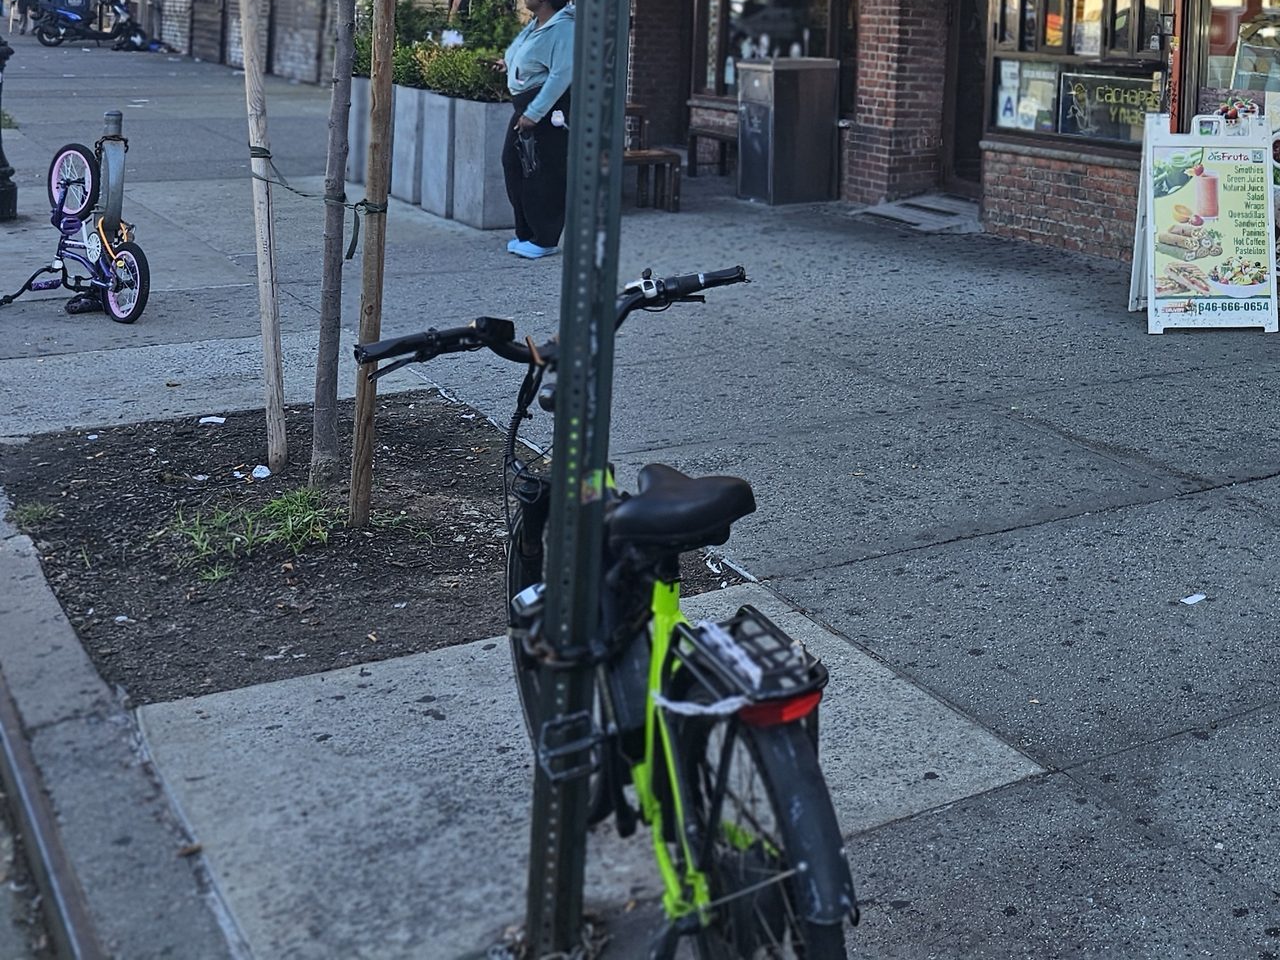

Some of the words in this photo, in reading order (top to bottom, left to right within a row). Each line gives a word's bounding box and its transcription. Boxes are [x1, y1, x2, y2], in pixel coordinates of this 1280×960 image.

[1002, 96, 1015, 117] A
[1207, 151, 1250, 161] disFruta
[1247, 174, 1264, 183] Juice
[1223, 183, 1246, 192] Natural
[1247, 183, 1264, 192] Juice
[1247, 192, 1264, 201] Salad
[1244, 201, 1264, 210] Wraps
[1228, 210, 1265, 219] Quesadillas
[1234, 219, 1265, 228] Sandwich
[1242, 228, 1265, 237] Paninis
[1233, 237, 1244, 246] Hot
[1245, 237, 1265, 246] Coffee
[1235, 246, 1266, 255] Pastelitos
[1198, 301, 1269, 312] 646-666-0654
